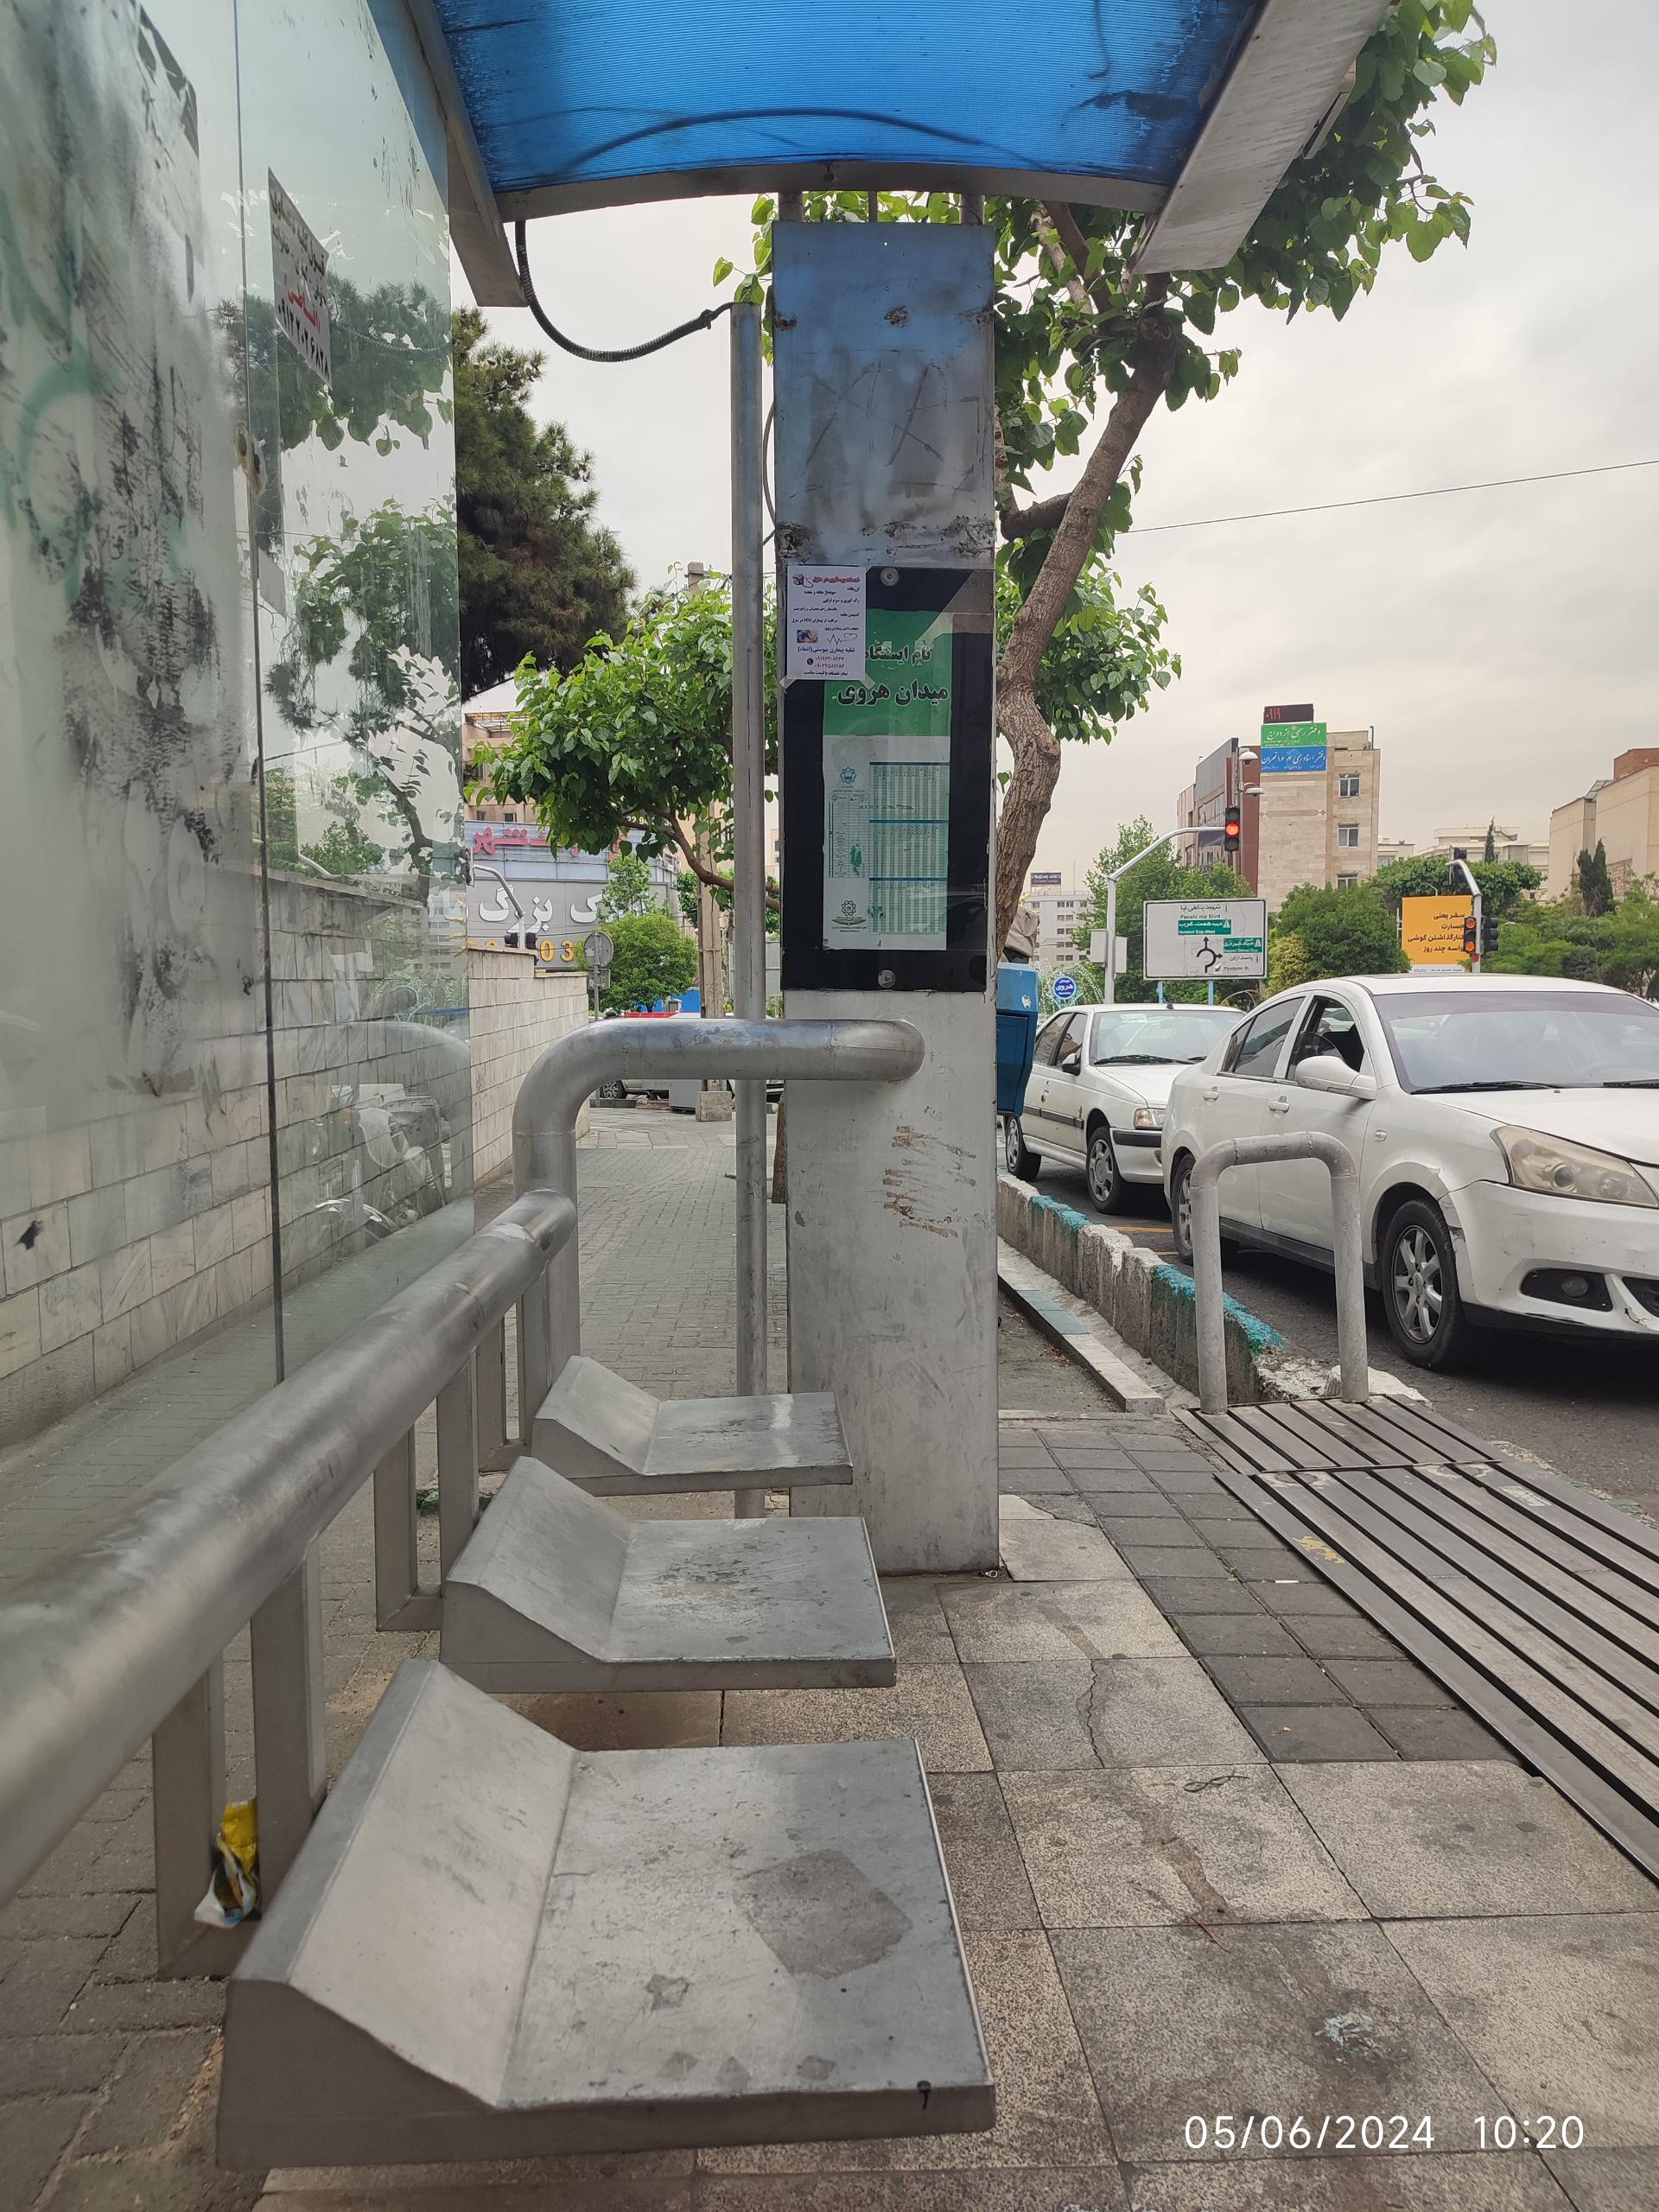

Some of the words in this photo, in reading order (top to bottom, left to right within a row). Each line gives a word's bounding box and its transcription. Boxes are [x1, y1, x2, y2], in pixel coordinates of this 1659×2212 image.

[912, 645, 931, 665] نام
[837, 683, 891, 706] هروی
[895, 678, 949, 706] میدان
[1267, 728, 1289, 741] ازدواج
[1291, 728, 1306, 739] رسمی
[1306, 724, 1321, 737] دفتر
[1262, 751, 1278, 765] تهران
[1313, 750, 1325, 764] دفتر
[479, 885, 554, 933] بزرگ
[1407, 933, 1427, 943] گوشی
[1433, 945, 1446, 954] چند
[1055, 983, 1074, 992] هروی
